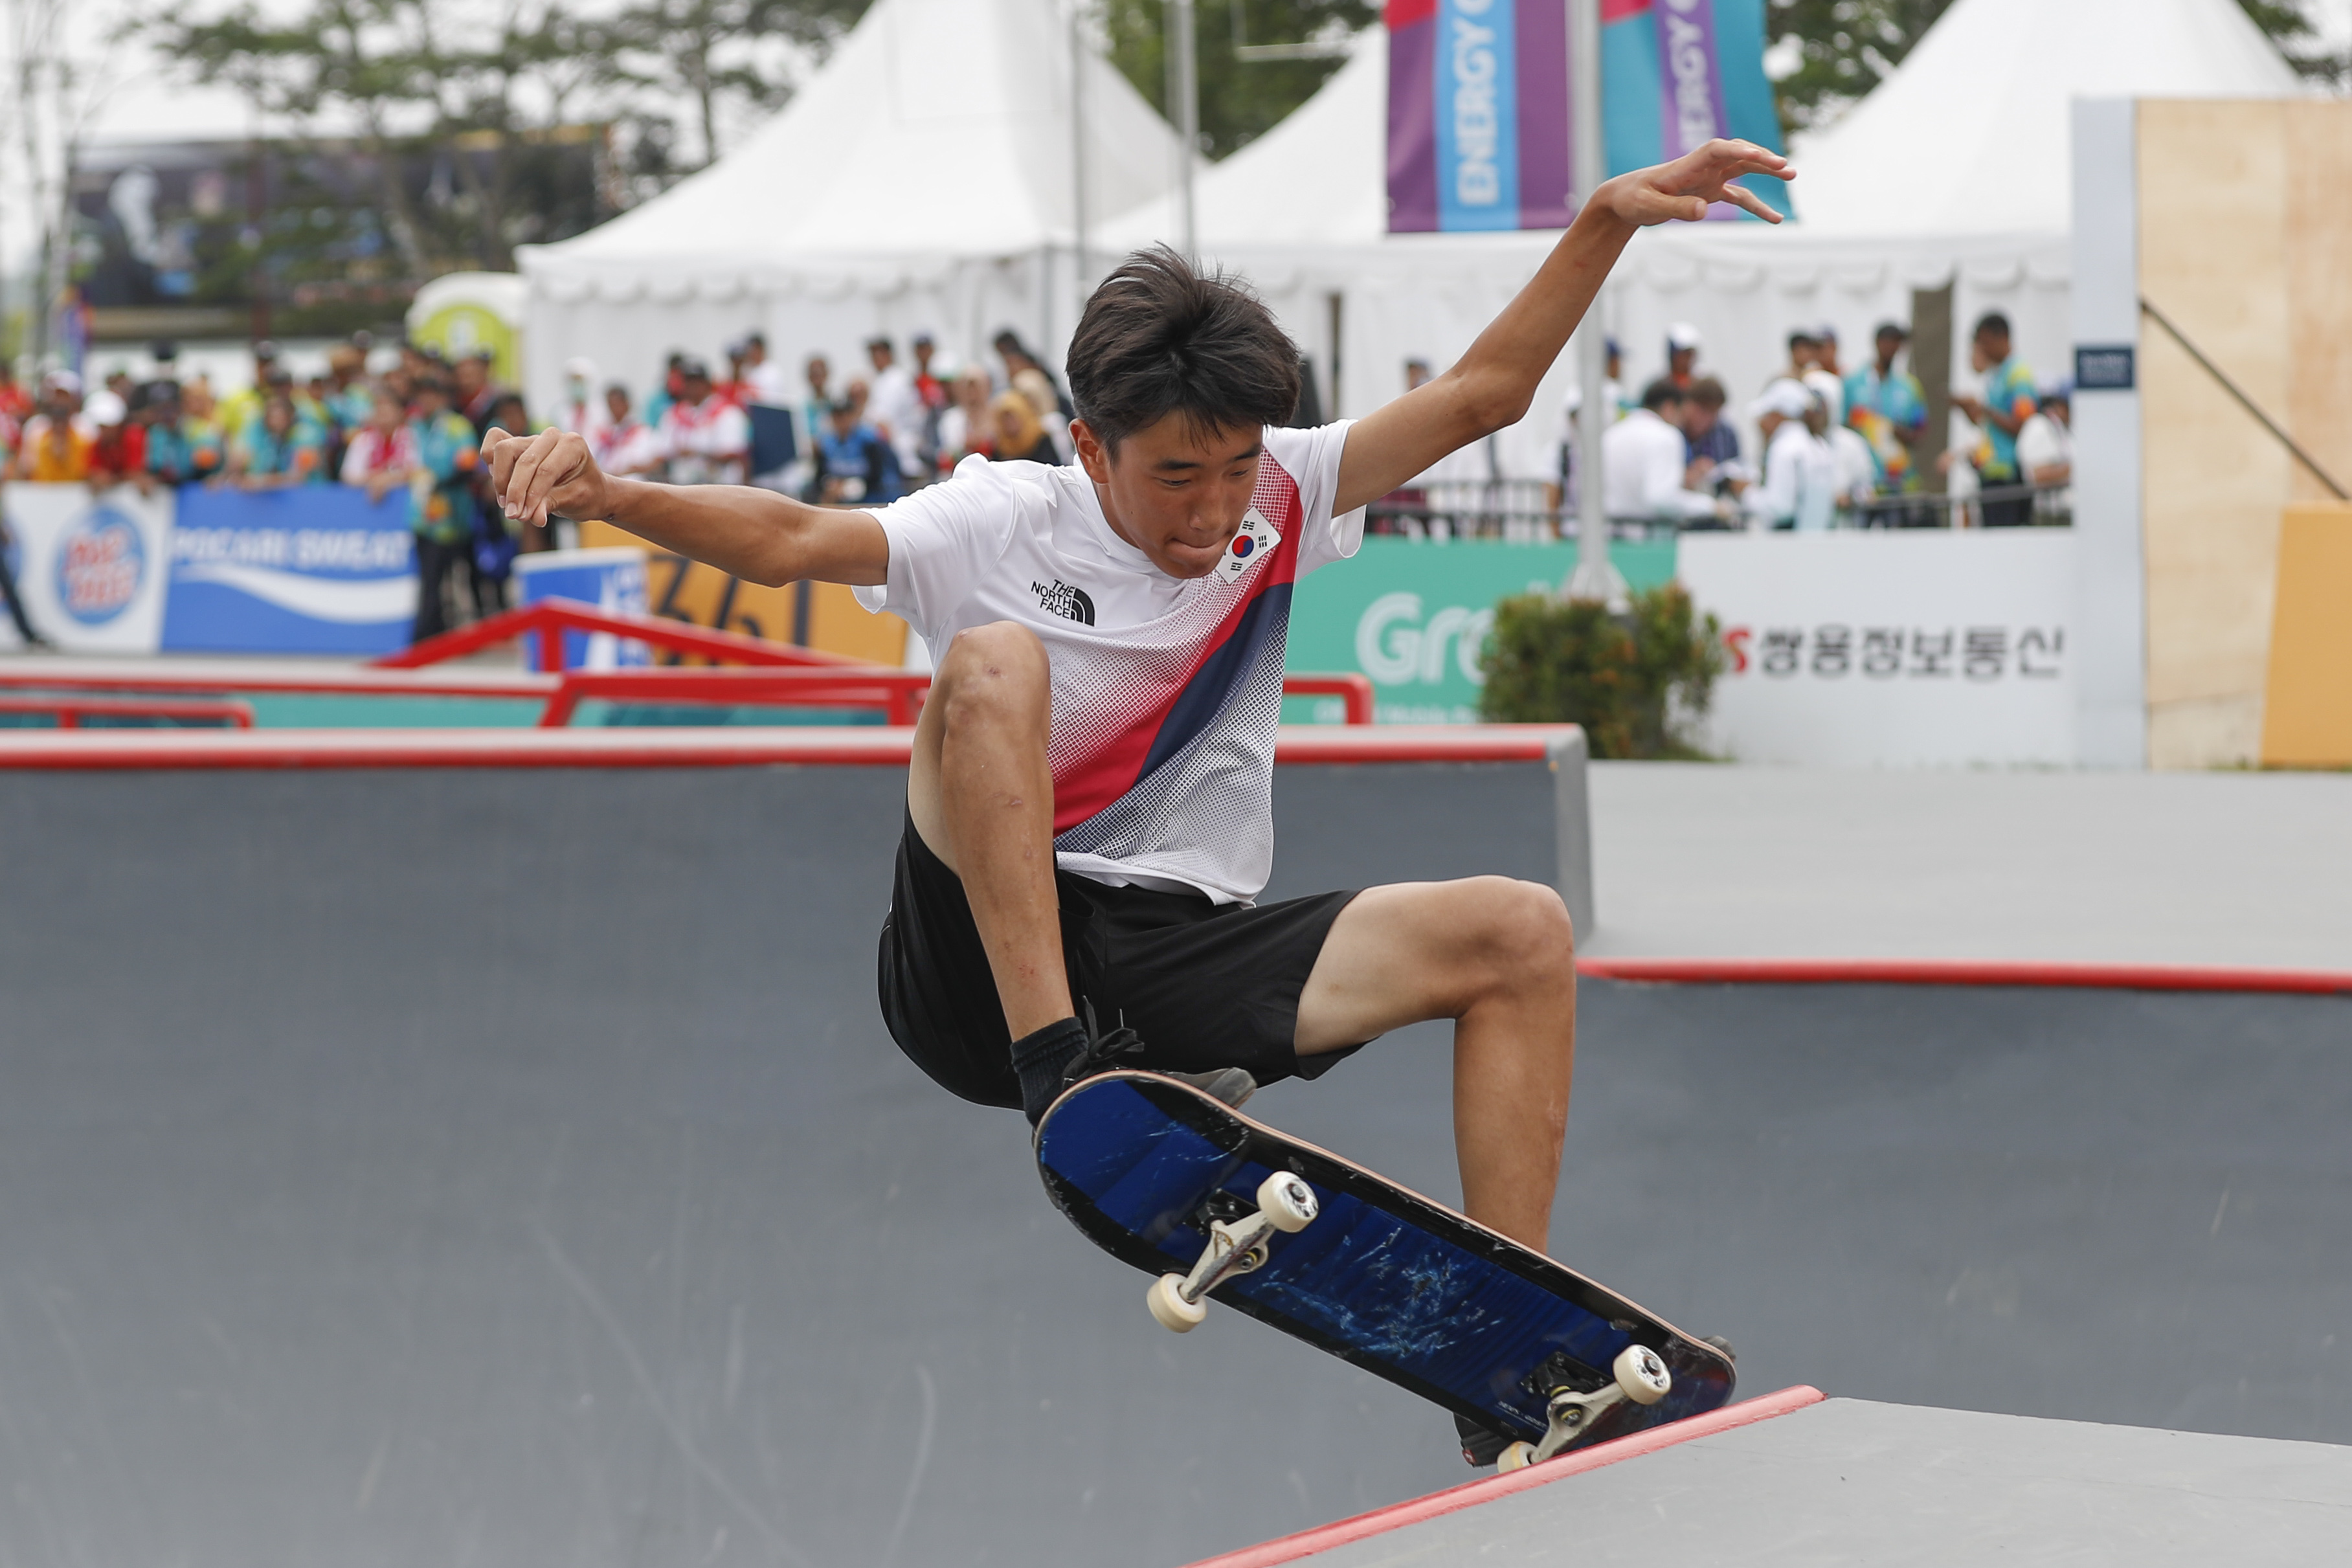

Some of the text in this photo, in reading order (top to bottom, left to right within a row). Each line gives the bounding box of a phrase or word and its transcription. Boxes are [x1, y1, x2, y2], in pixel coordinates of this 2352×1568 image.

[1664, 13, 1717, 153] NERGY
[1452, 16, 1499, 207] ENERGY
[1031, 581, 1071, 609] NORTH
[1052, 579, 1075, 598] THE
[1040, 598, 1070, 619] FACE
